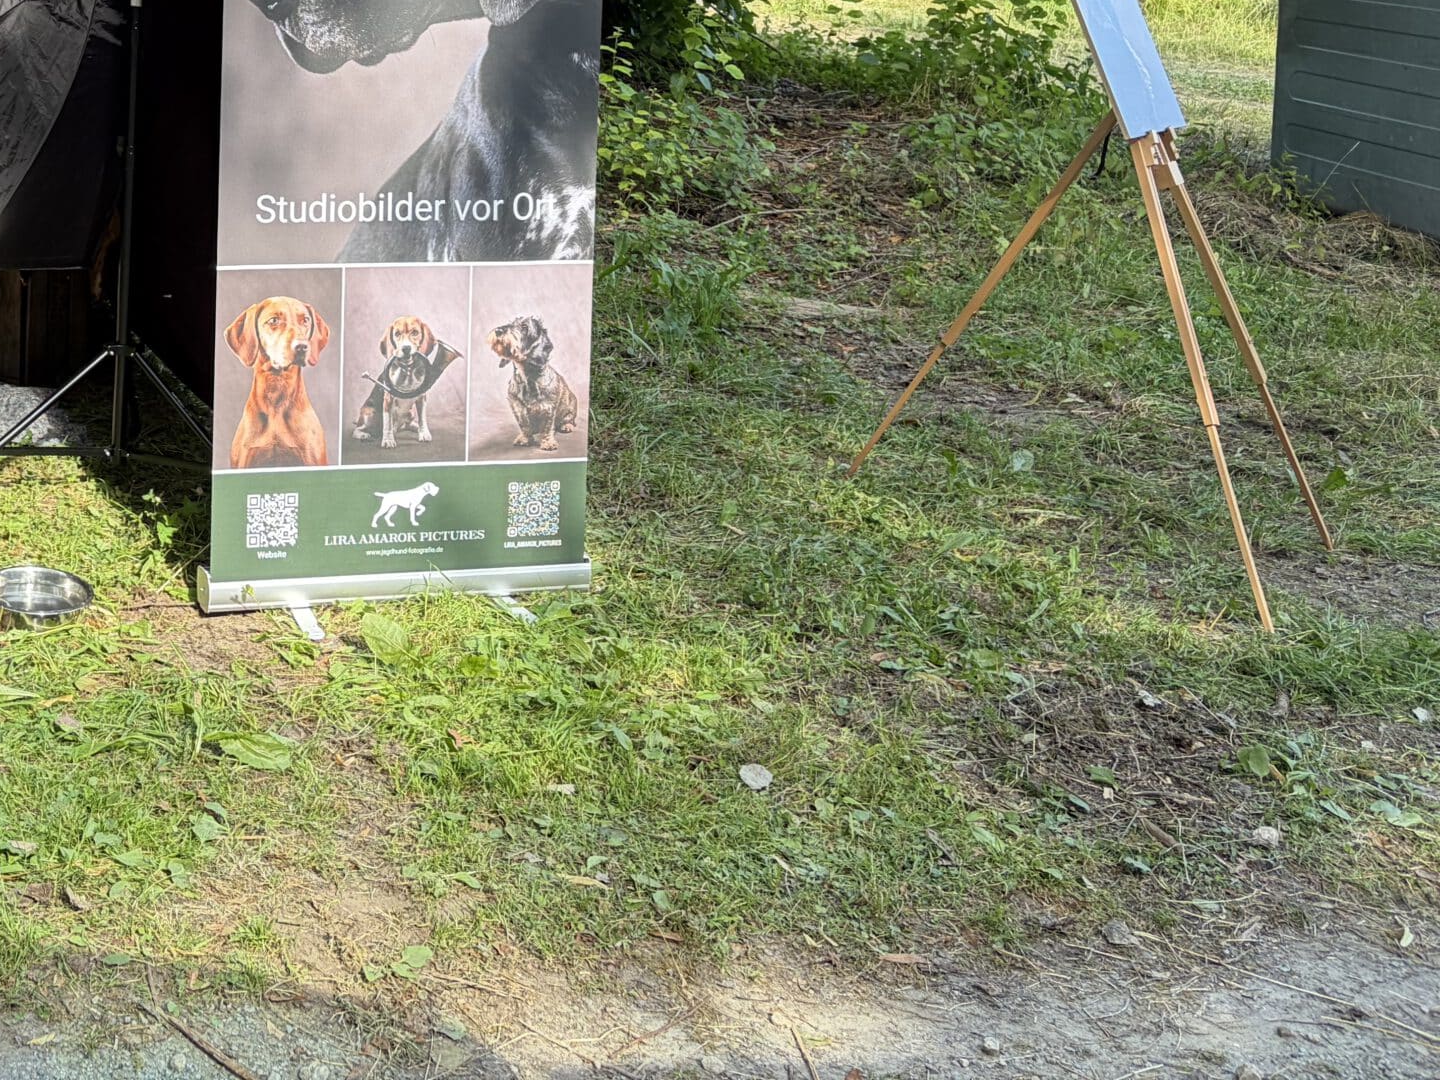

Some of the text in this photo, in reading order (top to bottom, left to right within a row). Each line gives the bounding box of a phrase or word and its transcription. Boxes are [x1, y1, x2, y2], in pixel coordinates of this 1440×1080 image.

[255, 191, 557, 224] Studiobilder vor Ort
[324, 529, 487, 547] LIRA AMAROK PICTURES
[257, 550, 288, 560] Website
